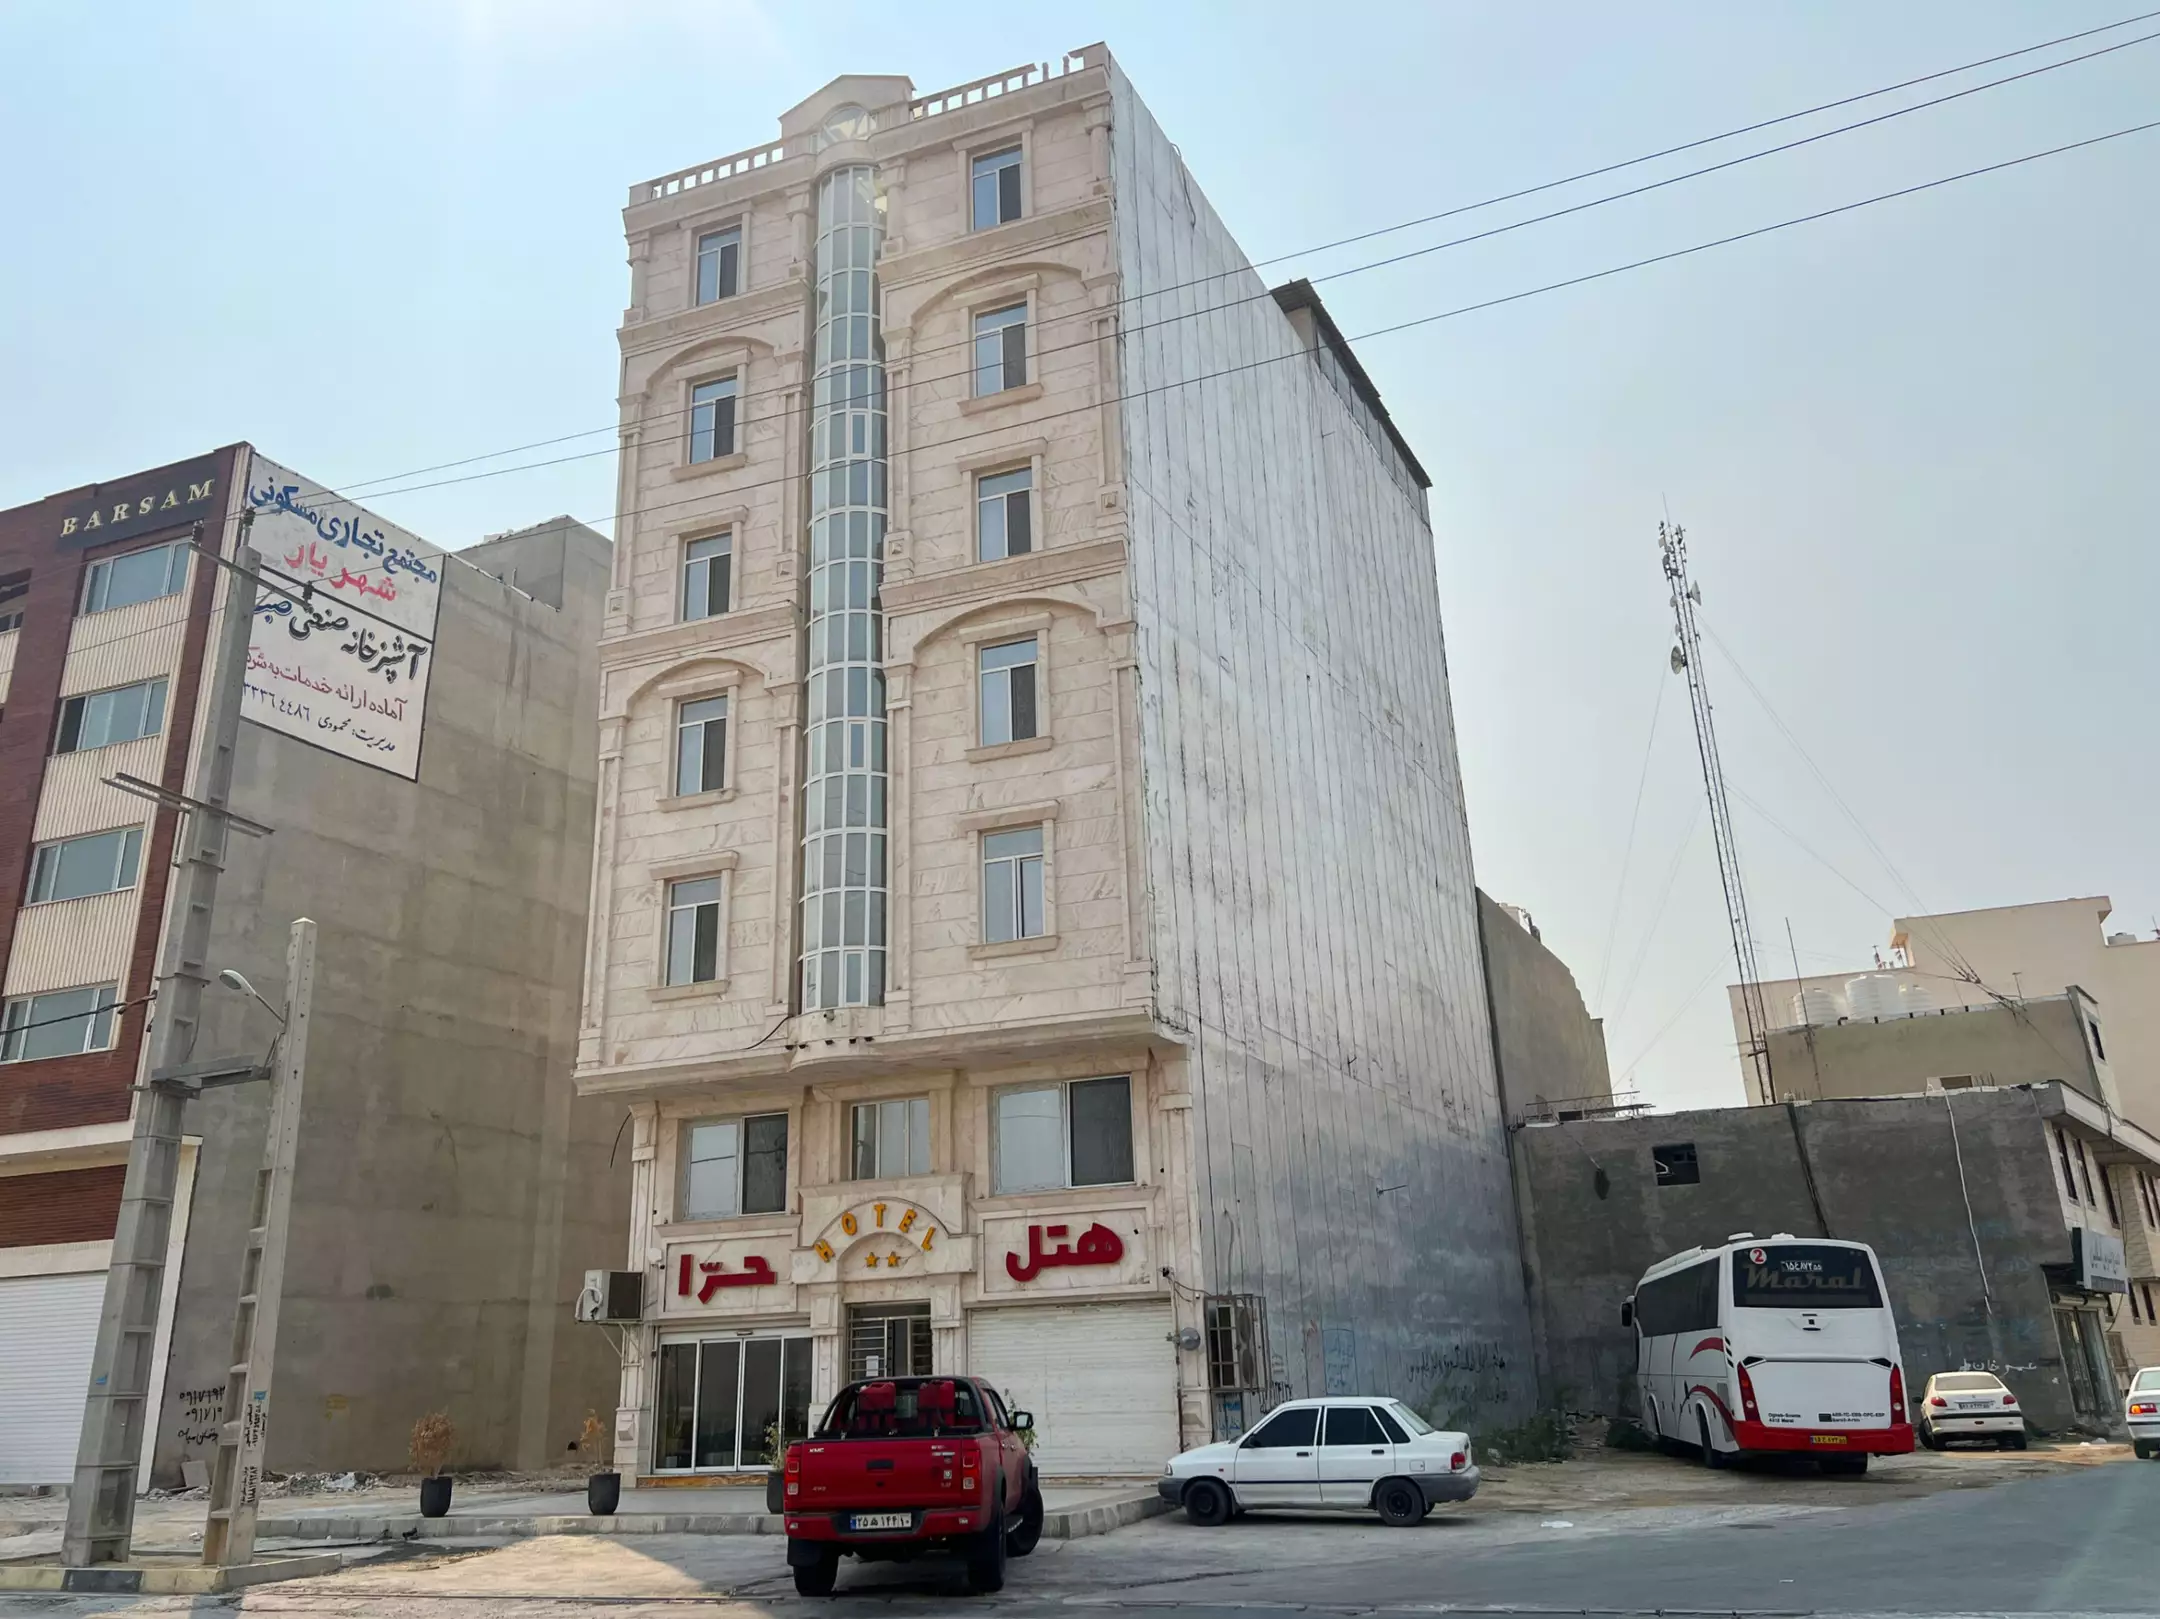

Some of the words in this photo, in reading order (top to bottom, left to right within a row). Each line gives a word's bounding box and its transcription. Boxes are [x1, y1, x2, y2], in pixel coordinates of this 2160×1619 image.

[60, 479, 215, 538] BARSAM
[250, 477, 317, 525] مسکونی
[317, 516, 385, 559] تجاری
[383, 547, 437, 584] مجتمع
[268, 662, 280, 679] به
[341, 628, 428, 684] آشپزخانه
[280, 665, 333, 695] خدمات
[317, 715, 351, 732] محمودی
[369, 697, 408, 721] آماده
[813, 1203, 938, 1263] HOTEL
[1006, 1222, 1125, 1283] هتل
[1753, 1249, 1764, 1262] 2
[1743, 1263, 1866, 1289] Maral
